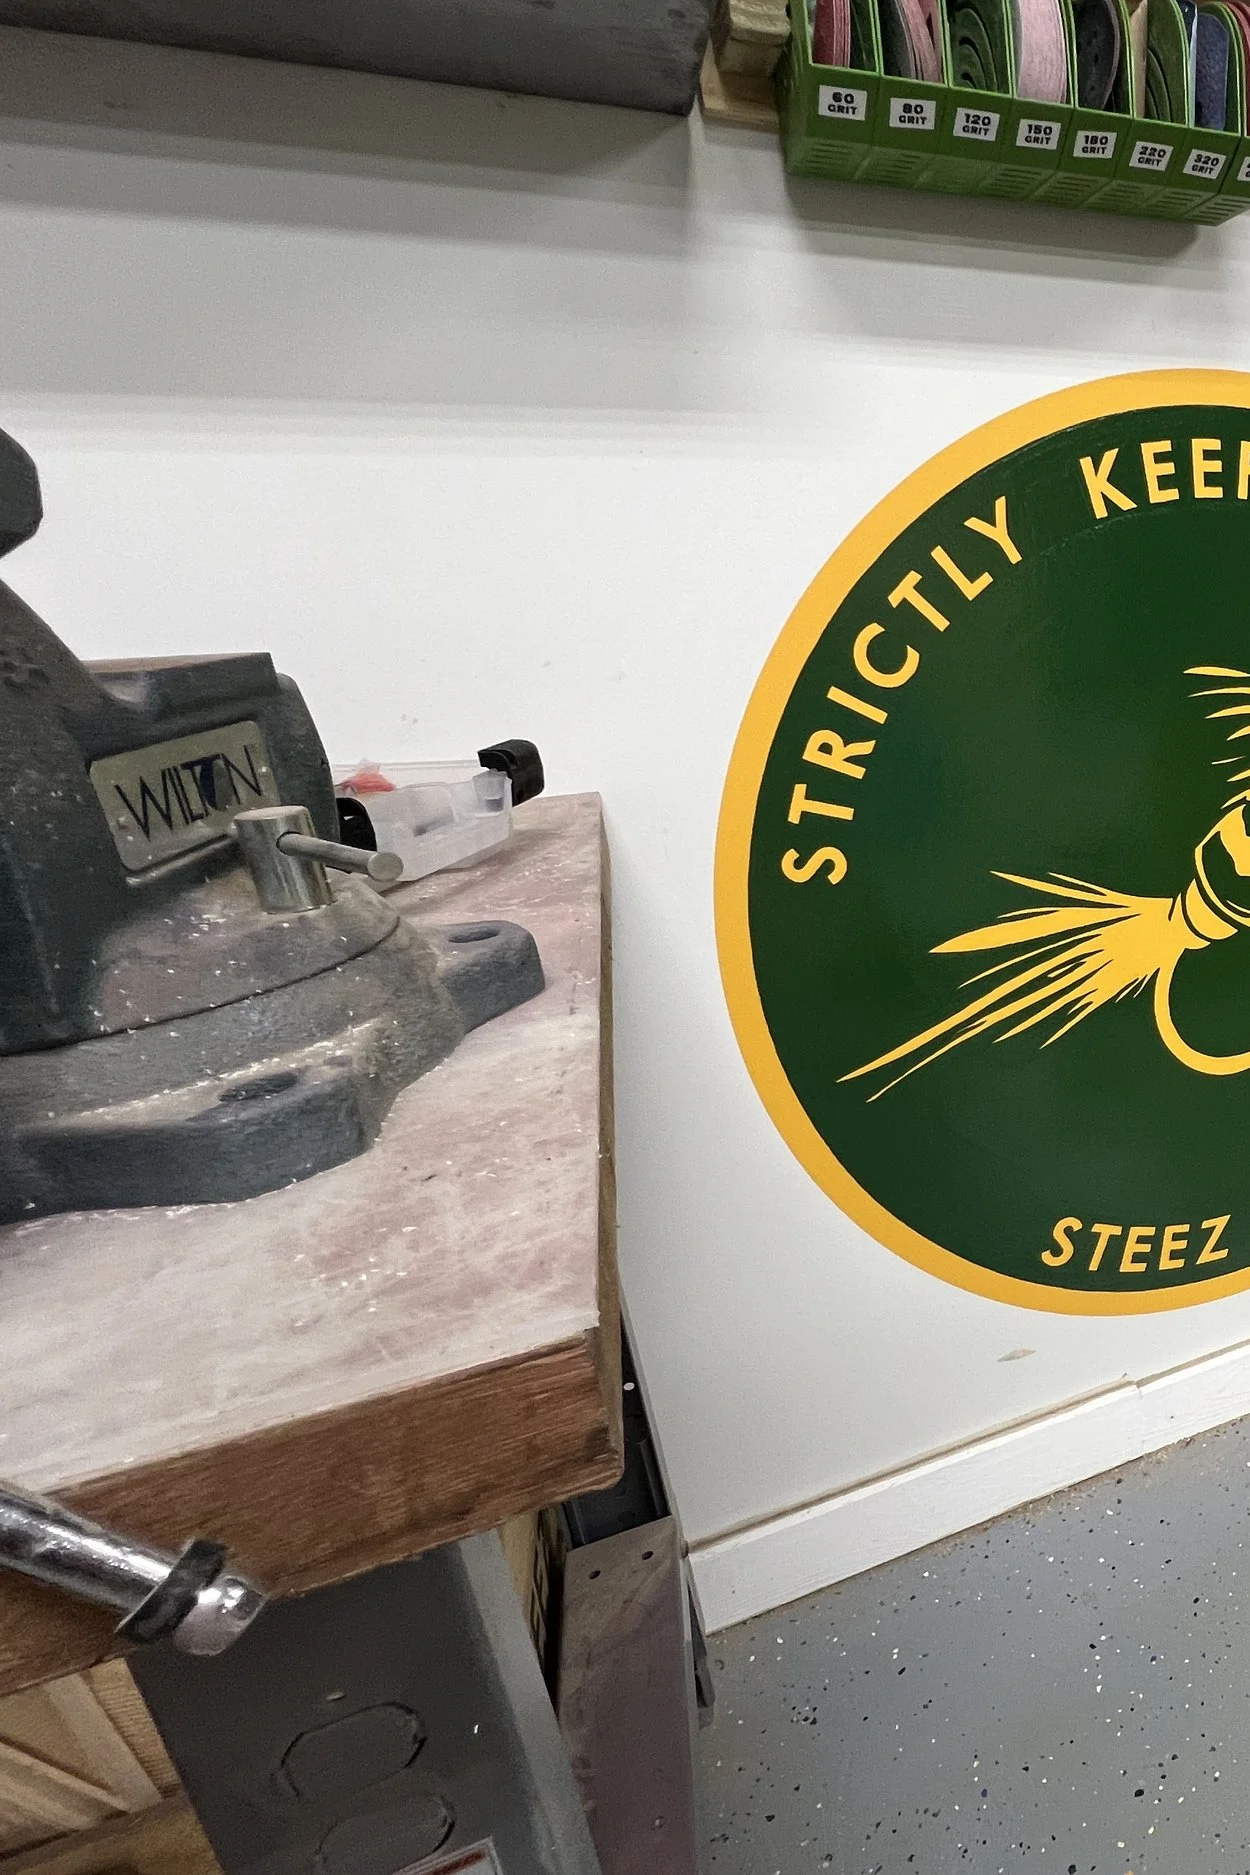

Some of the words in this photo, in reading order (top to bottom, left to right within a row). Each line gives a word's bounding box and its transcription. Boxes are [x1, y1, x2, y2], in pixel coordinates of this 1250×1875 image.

[832, 92, 854, 104] 60
[828, 104, 858, 115] GRIT
[902, 103, 924, 114] 80
[898, 115, 927, 125] GRIT
[964, 113, 991, 126] 120
[962, 124, 990, 136] GRIT
[1027, 124, 1053, 136] 150
[1024, 135, 1051, 145] GRIT
[1084, 135, 1109, 145] 180
[1082, 146, 1107, 154] GRIT
[1139, 146, 1167, 158] 220
[1137, 156, 1162, 167] GRIT
[1194, 153, 1220, 167] 320
[1191, 164, 1215, 175] GRIT
[781, 495, 1026, 886] STRICTLY
[114, 743, 264, 842] WILTON
[1041, 1213, 1232, 1274] STEEZ
